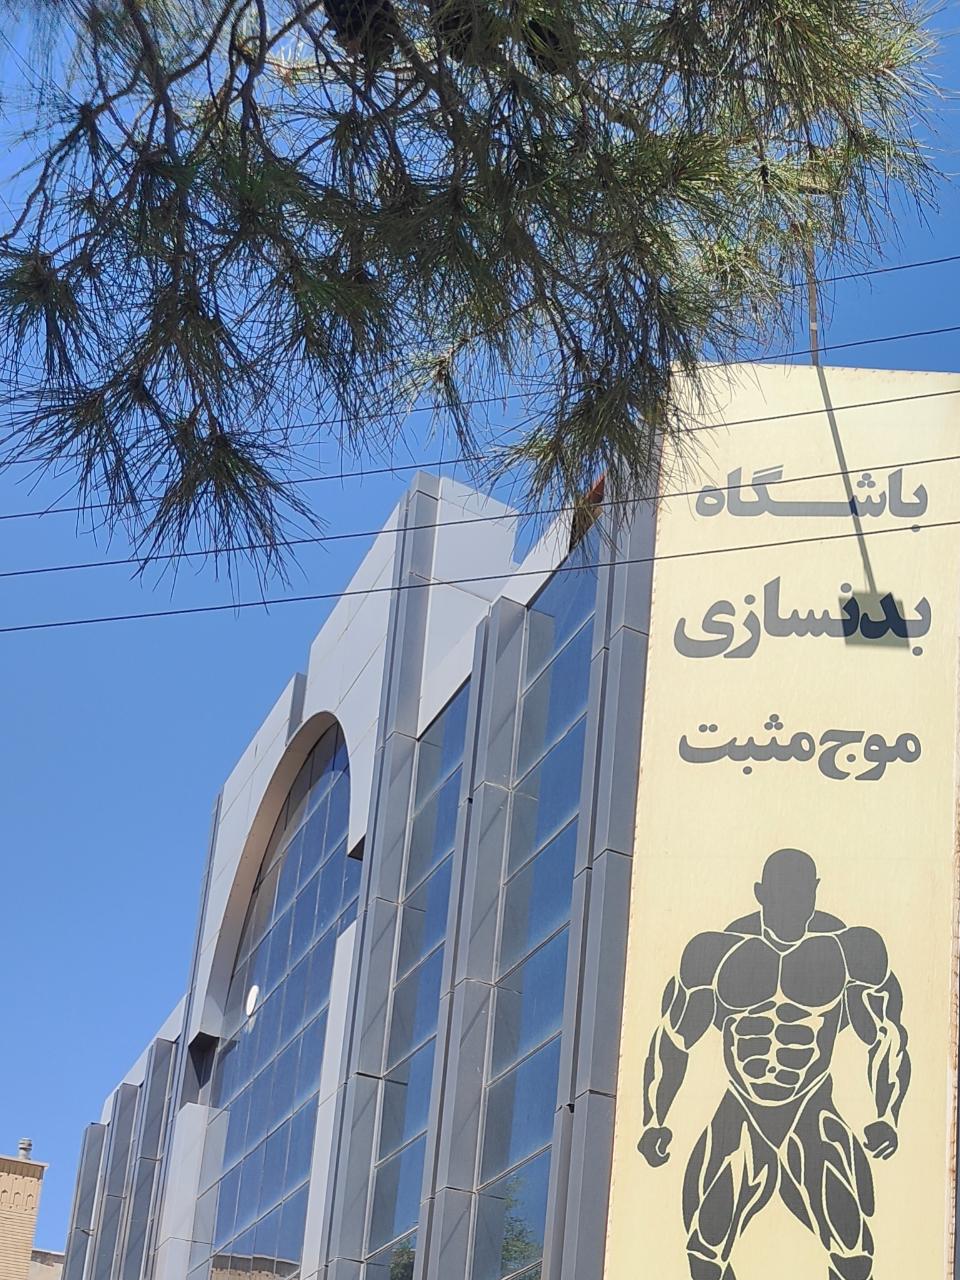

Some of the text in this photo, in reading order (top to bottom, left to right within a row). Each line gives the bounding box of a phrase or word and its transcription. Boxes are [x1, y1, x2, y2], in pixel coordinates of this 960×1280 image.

[695, 464, 929, 533] باشگاه
[673, 576, 932, 659] بدنسازی
[678, 713, 922, 781] موج مثبت
